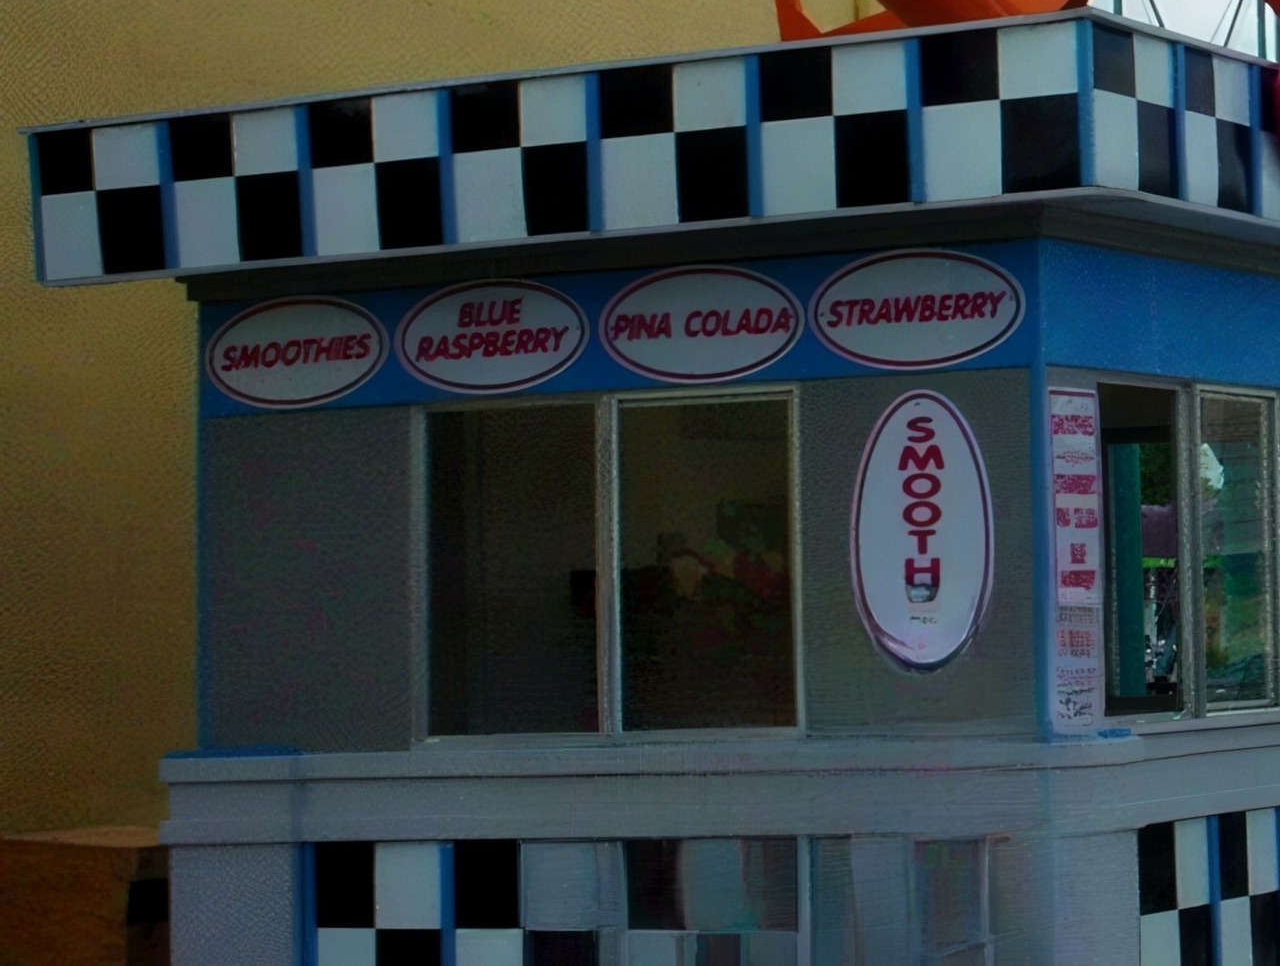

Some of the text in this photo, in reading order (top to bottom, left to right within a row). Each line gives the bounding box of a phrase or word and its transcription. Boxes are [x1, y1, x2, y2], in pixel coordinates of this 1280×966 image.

[457, 297, 524, 328] BLUE
[684, 306, 792, 337] COLADA
[827, 290, 1006, 328] STRAWBERRY
[221, 333, 373, 371] SMOOTHIES
[415, 326, 569, 362] RASPBERRY
